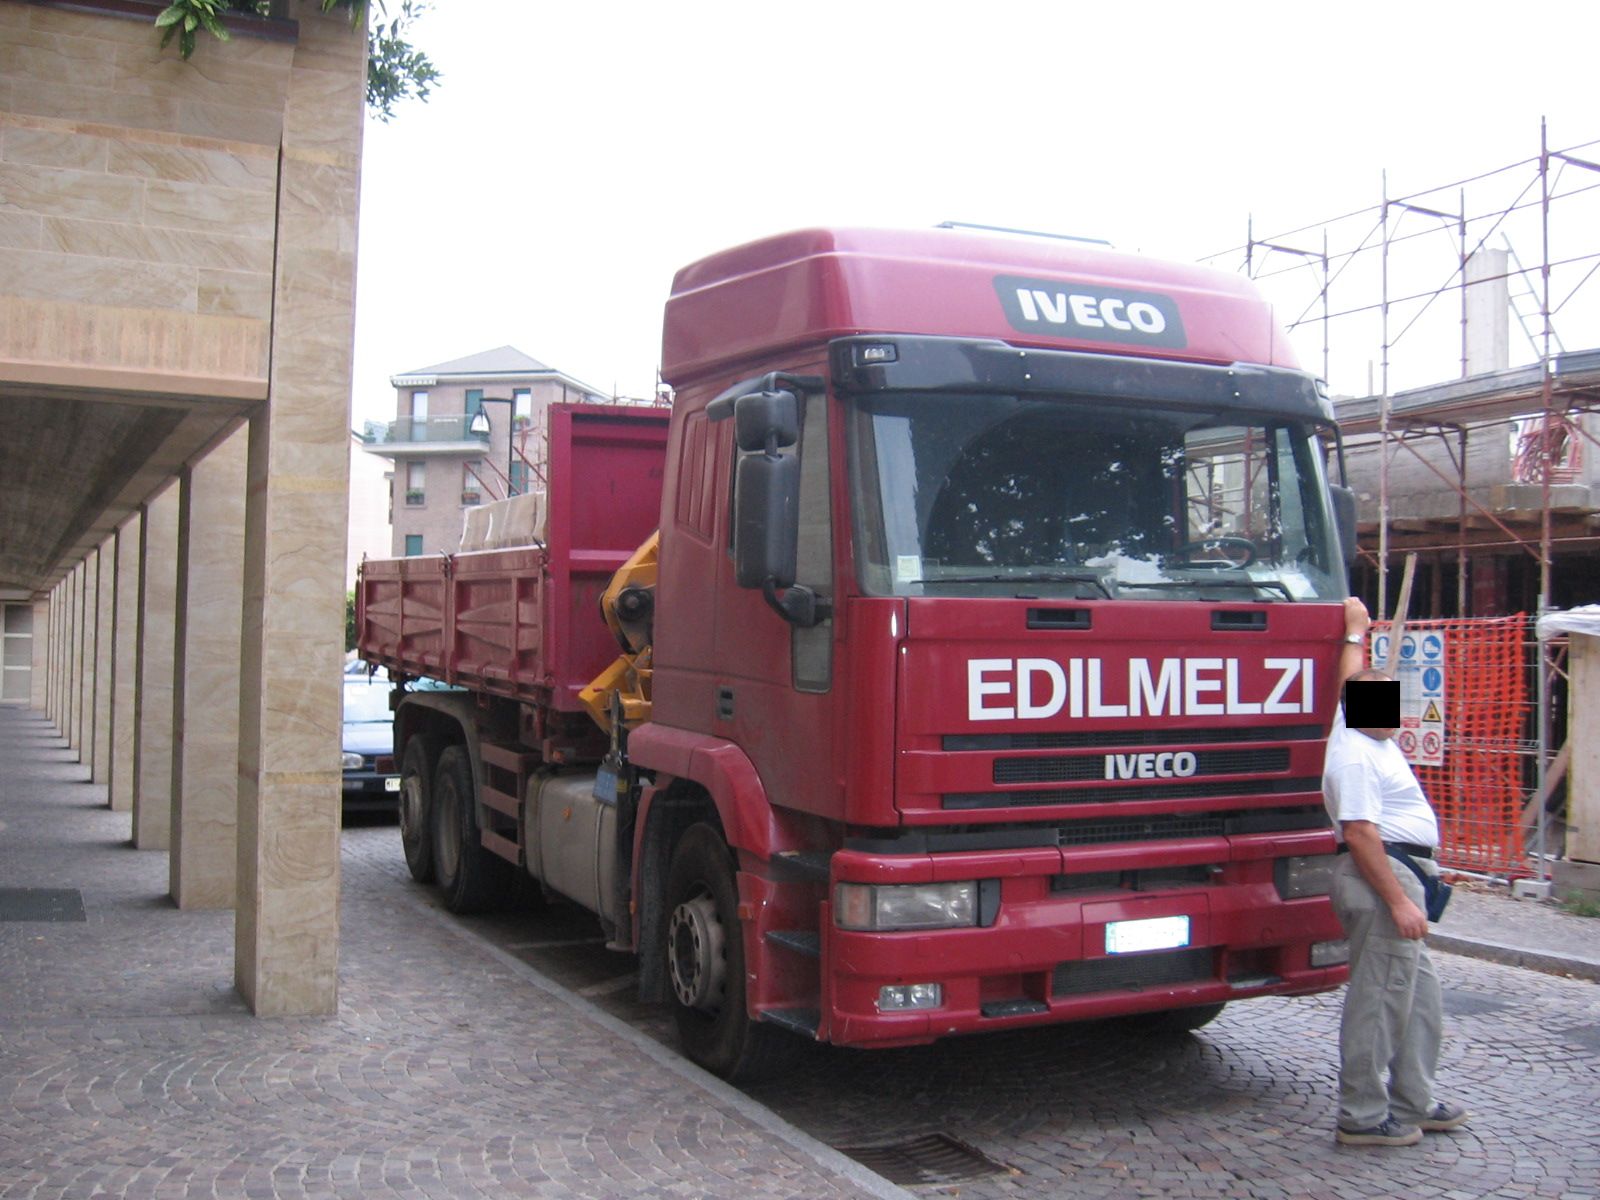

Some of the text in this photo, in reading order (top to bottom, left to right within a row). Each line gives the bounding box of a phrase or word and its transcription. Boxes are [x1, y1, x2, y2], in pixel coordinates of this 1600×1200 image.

[1016, 288, 1166, 334] IVECO
[968, 658, 1314, 720] EDILMELZI
[1104, 752, 1197, 780] IVECO
